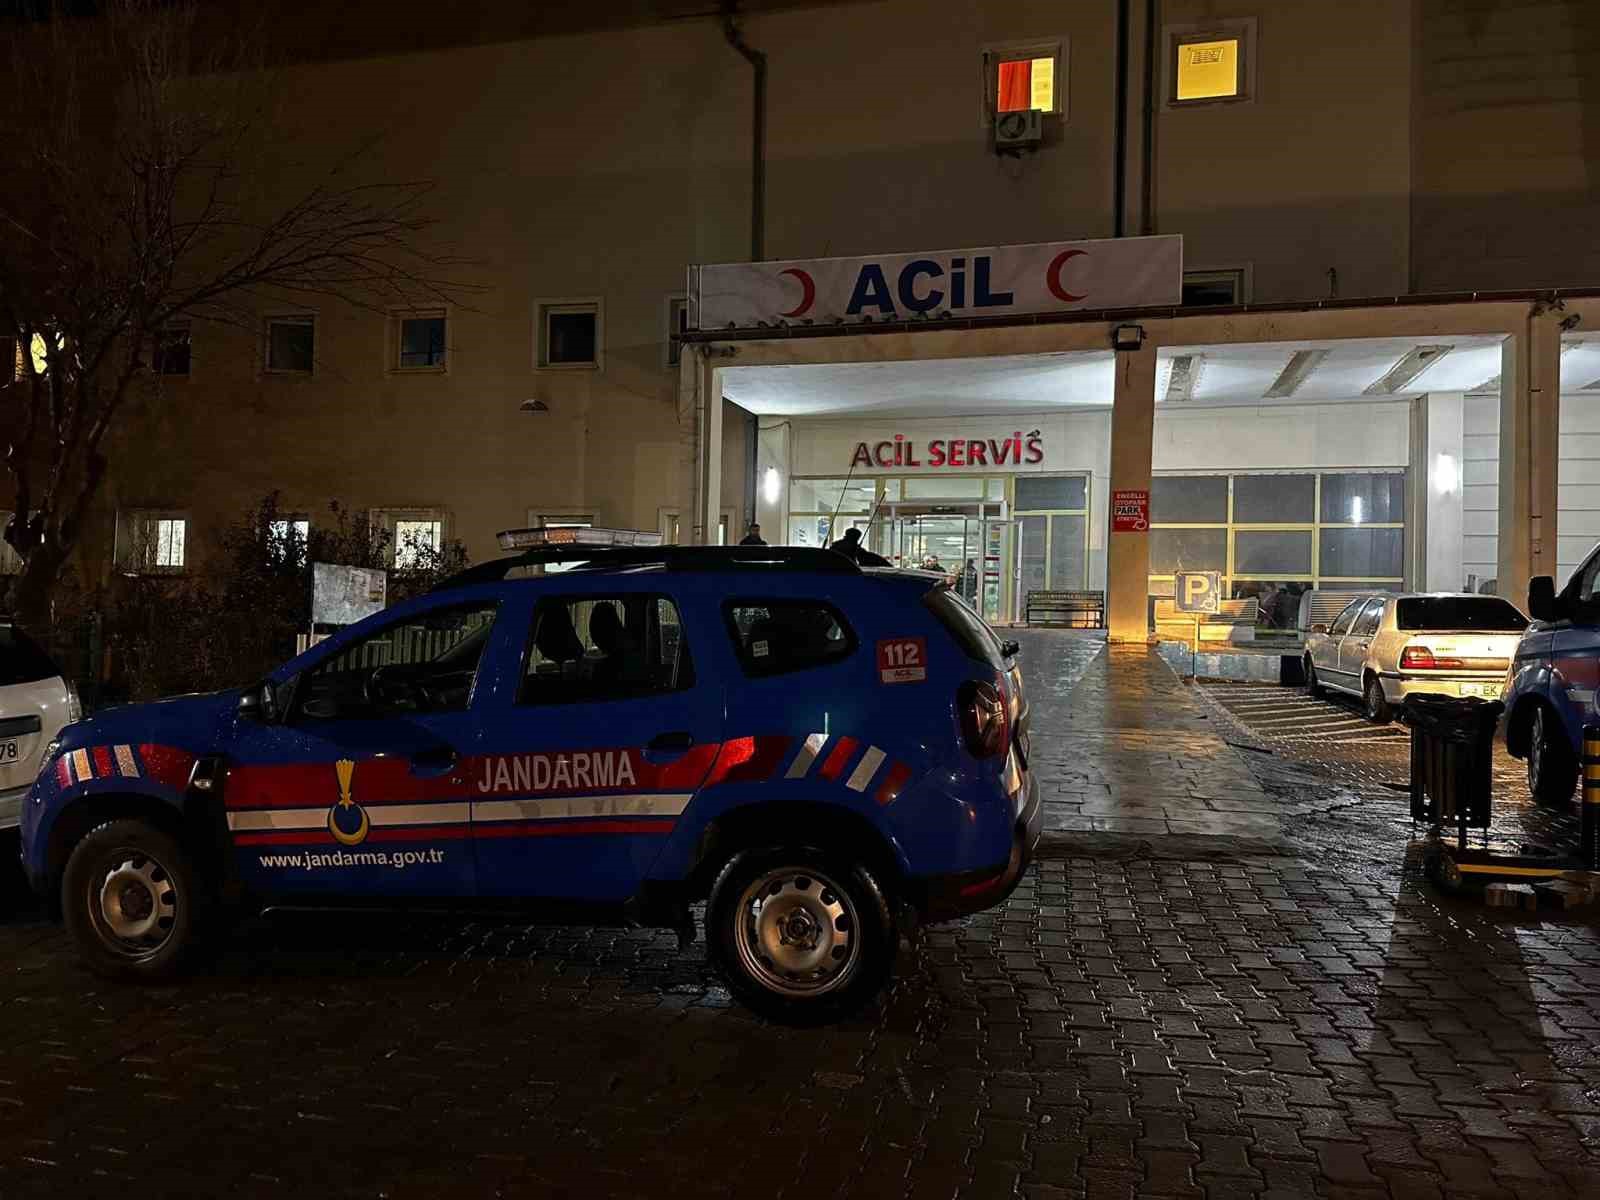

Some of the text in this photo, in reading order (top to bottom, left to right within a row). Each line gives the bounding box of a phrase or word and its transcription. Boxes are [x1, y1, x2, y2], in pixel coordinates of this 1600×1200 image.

[1115, 506, 1140, 514] PARK
[1185, 575, 1209, 605] P
[885, 642, 920, 666] 112
[478, 750, 636, 793] JANDARMA
[259, 848, 444, 871] www.jandarma.gov.tr
